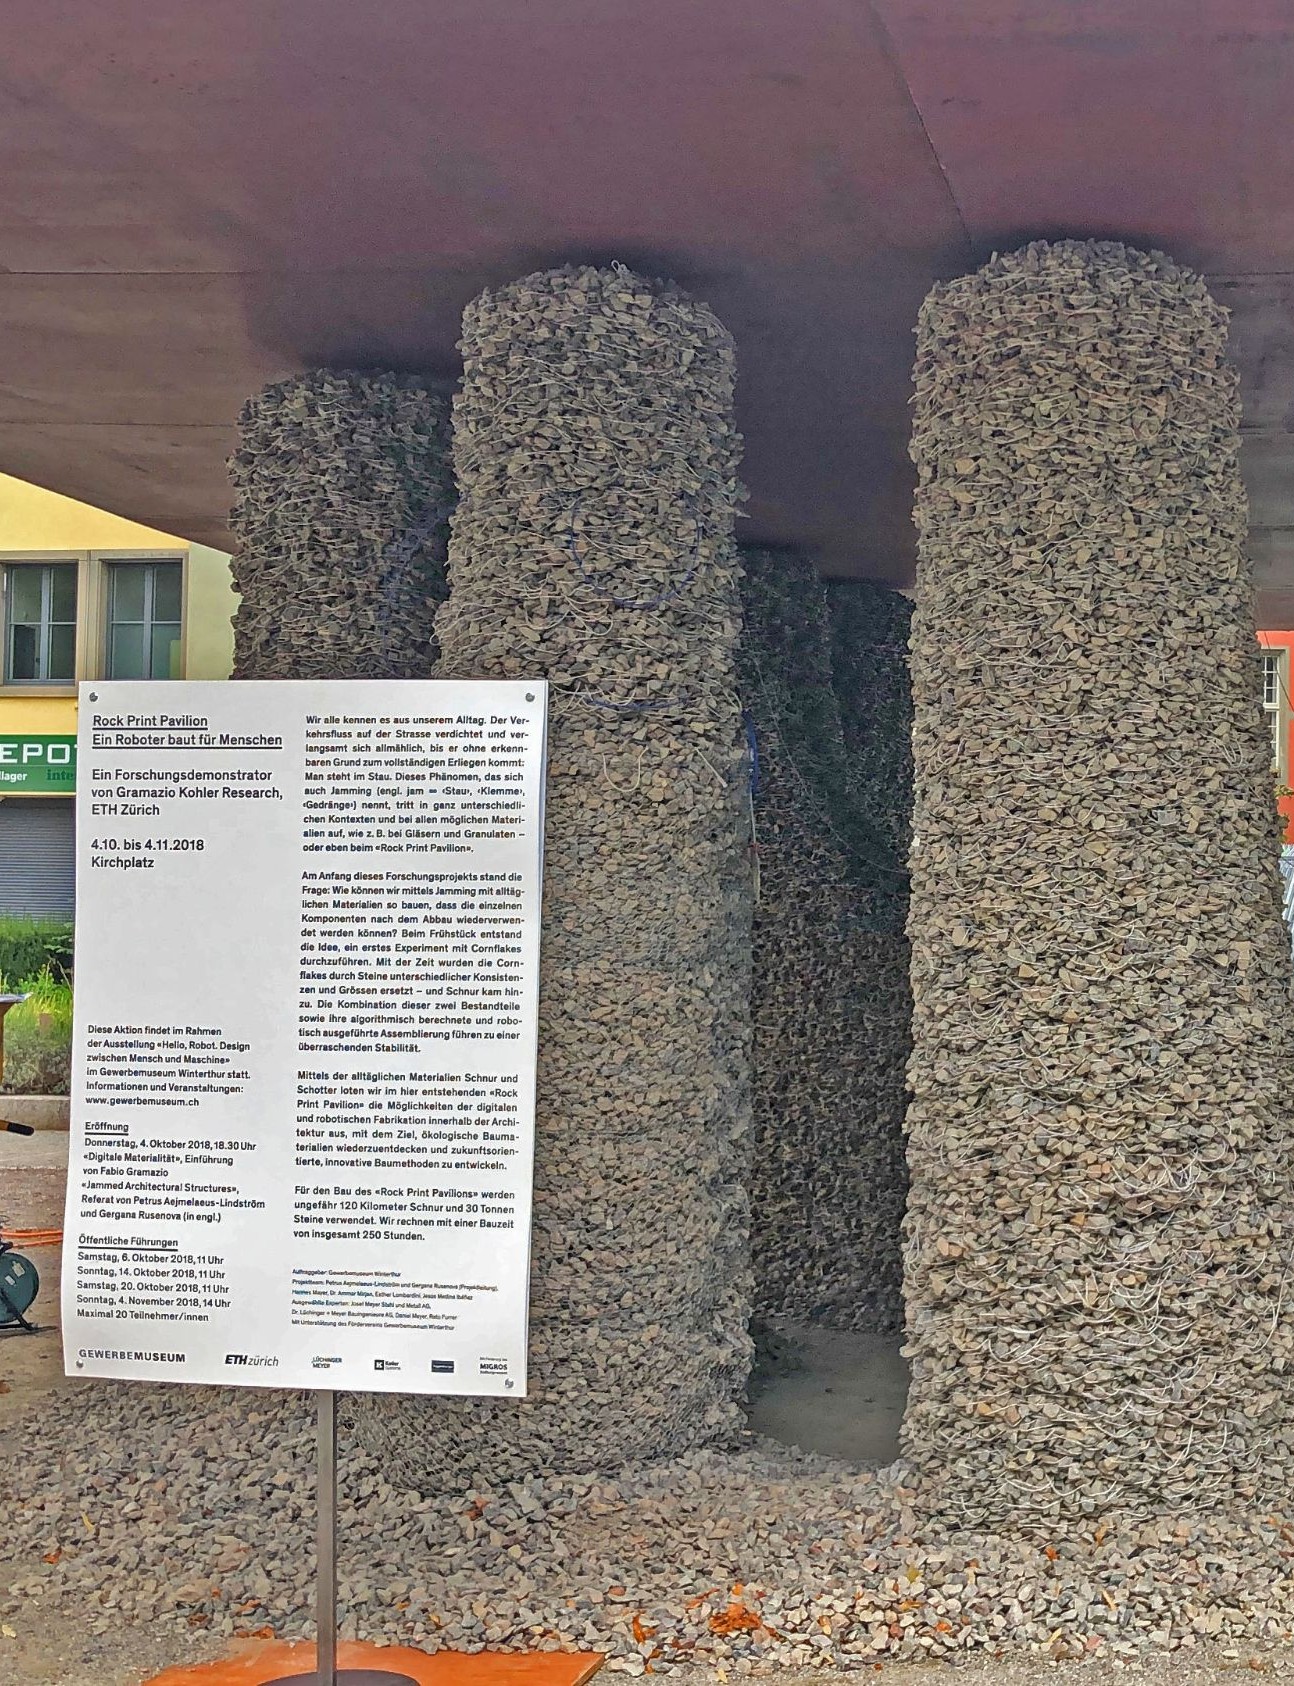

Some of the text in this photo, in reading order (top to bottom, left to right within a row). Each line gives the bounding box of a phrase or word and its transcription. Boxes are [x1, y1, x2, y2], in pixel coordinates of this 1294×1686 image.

[93, 715, 208, 727] Rock Print Pavilion
[306, 715, 321, 724] Wir
[324, 715, 341, 724] alle
[343, 715, 377, 724] kennen
[456, 716, 487, 726] Alltag.
[490, 716, 507, 725] Der
[510, 716, 530, 725] Ver-
[92, 734, 283, 746] Ein Roboter baut für Menschen
[0, 743, 78, 764] EPO
[92, 769, 273, 784] Ein Forschungsdemonstrator
[91, 786, 283, 800] von Gramazio Kohler Research,
[91, 804, 160, 815] ETH Zürich
[91, 838, 205, 851] 4.10. bis 4.11.2018
[91, 856, 155, 870] Kirchplatz
[87, 1025, 222, 1035] Diese Aktion findet im Rahmen
[87, 1040, 102, 1048] der
[103, 1040, 156, 1051] Ausstellung
[189, 1041, 217, 1049] Robot.
[220, 1041, 251, 1052] Design
[86, 1053, 127, 1062] zwischen
[129, 1053, 164, 1062] Mensch
[165, 1054, 182, 1063] und
[86, 1067, 97, 1076] im
[99, 1067, 176, 1077] Gewerbemuseum
[178, 1069, 226, 1078] Winterthur
[86, 1081, 244, 1094] Informationen und Veranstaltungen:
[85, 1097, 200, 1107] www.gewerbemuseum.ch
[84, 1121, 129, 1132] Eröffnung
[84, 1138, 257, 1151] Donnerstag, 4. Oktober 2018, 18.30 Uhr
[184, 1154, 234, 1166] Einführung
[100, 1166, 125, 1175] Fabio
[126, 1167, 169, 1177] Gramazio
[125, 1182, 183, 1192] Architectural
[295, 1185, 515, 1199] Für den Bau des «Rock Print Pavilions» werden
[81, 1195, 115, 1205] Referat
[116, 1197, 132, 1205] von
[133, 1197, 162, 1206] Petrus
[294, 1201, 515, 1214] ungefähr 120 Kilometer Schnur und 30 Tonnen
[80, 1210, 222, 1223] und Gergana Rusenova (in engl.)
[293, 1214, 515, 1229] Steine verwendet. Wir rechnen mit einer Bauzeit
[79, 1234, 178, 1248] Öffentliche Führungen
[311, 1229, 361, 1240] insgesamt
[362, 1231, 382, 1239] 250
[384, 1231, 425, 1241] Stunden.
[77, 1252, 224, 1265] Samstag, 6. Oktober 2018, 11 Uhr
[77, 1266, 226, 1279] Sonntag, 14. Oktober 2018, 11 Uhr
[77, 1280, 230, 1294] Samstag, 20. Oktober 2018, 11 Uhr
[76, 1294, 231, 1308] Sonntag, 4. November 2018, 14 Uhr
[77, 1309, 209, 1322] Maximal 20 Teilnehmer/innen
[79, 1350, 186, 1363] GEWERBEMUSEUM
